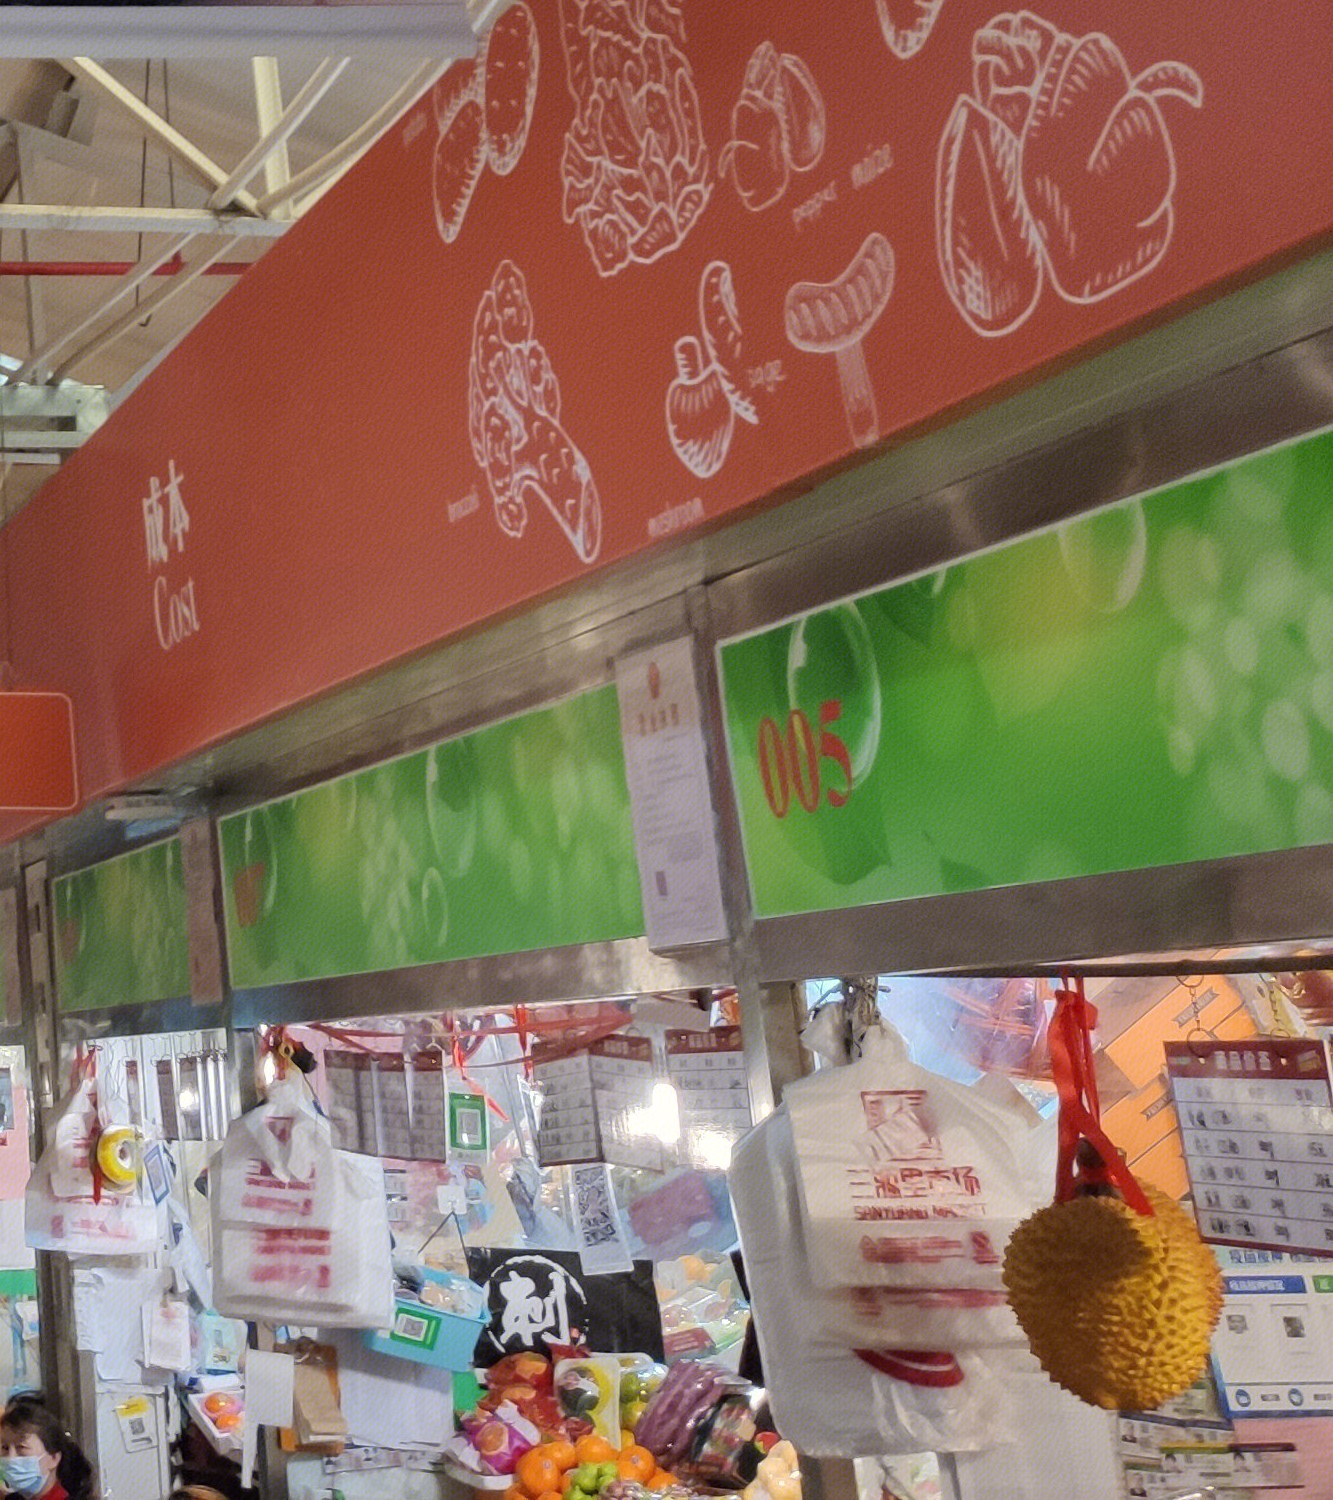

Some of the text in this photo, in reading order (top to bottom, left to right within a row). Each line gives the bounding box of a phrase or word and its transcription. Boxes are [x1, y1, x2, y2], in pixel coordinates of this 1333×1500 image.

[141, 459, 191, 569] 成本
[152, 575, 201, 651] Cost
[758, 699, 853, 819] 005
